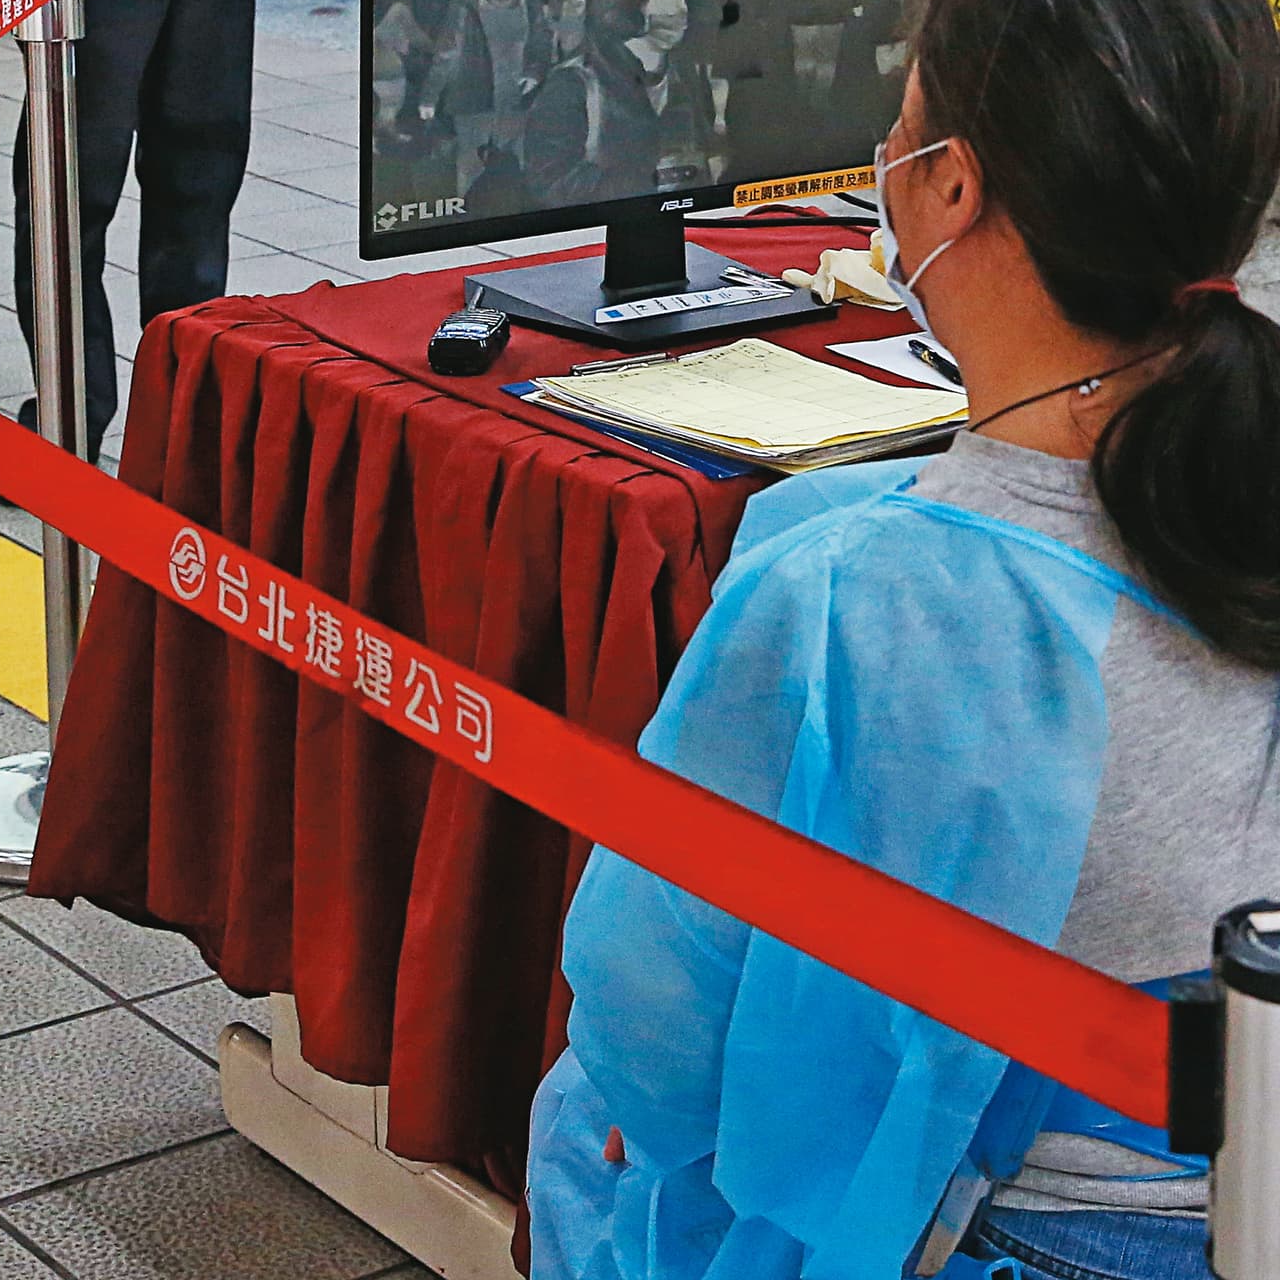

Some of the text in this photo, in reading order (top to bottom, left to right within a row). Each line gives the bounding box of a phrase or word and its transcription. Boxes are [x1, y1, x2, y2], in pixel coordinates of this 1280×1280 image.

[400, 197, 467, 223] FLIR
[660, 198, 694, 212] ASUS
[215, 551, 494, 765] 台北捷運公司
